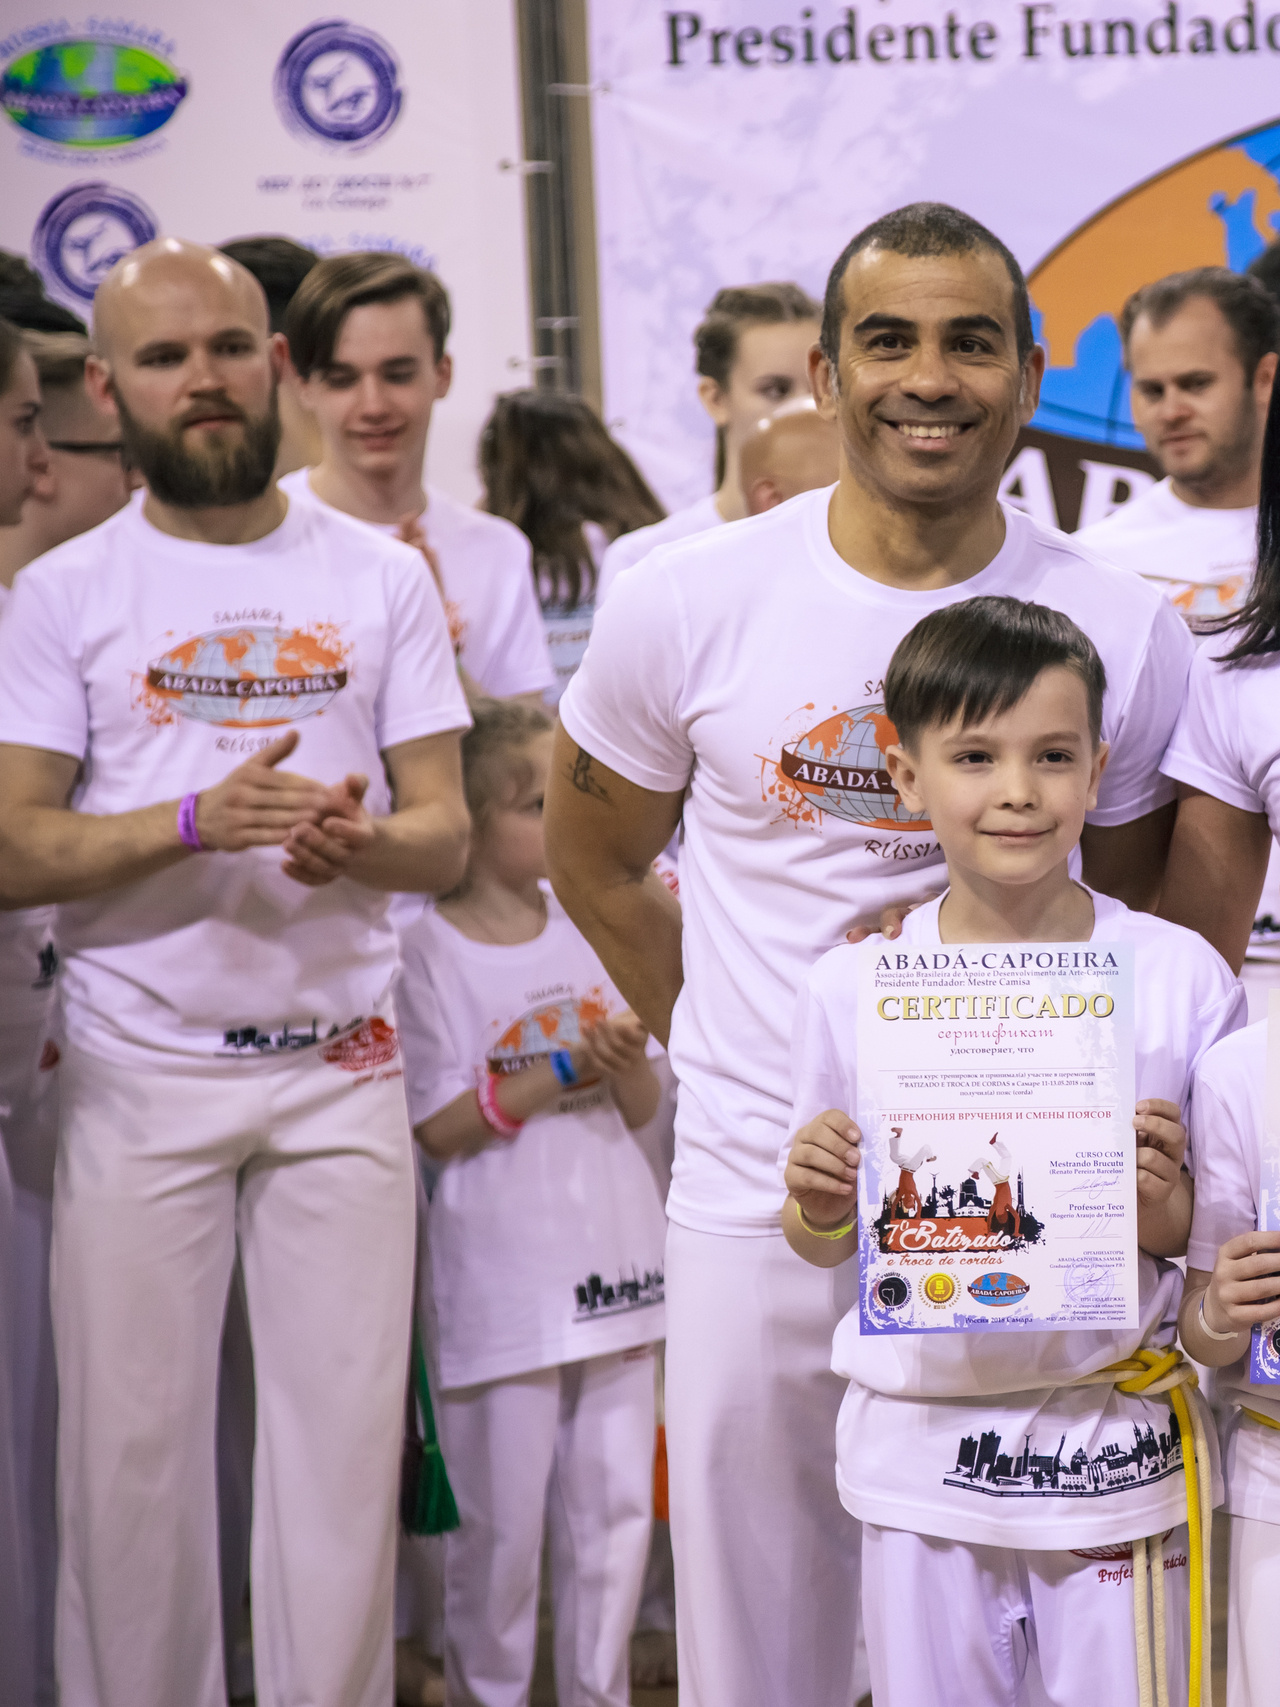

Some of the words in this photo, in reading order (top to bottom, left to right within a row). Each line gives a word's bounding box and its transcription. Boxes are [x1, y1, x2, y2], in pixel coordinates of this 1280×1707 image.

[664, 10, 998, 66] Presidente
[874, 947, 1117, 969] ABADÁ-CAPOEIRA
[874, 978, 919, 987] Presidente
[921, 977, 964, 986] Fundador:
[967, 977, 996, 985] Mestre
[998, 976, 1030, 985] Camisa
[876, 993, 1114, 1021] CERTIFICADO
[937, 1022, 1054, 1046] сертификат
[889, 1112, 955, 1122] ЦЕРЕМОНИЯ
[958, 1112, 1013, 1120] ВРУЧЕНИЯ
[1025, 1111, 1064, 1119] СМЕНЫ
[1067, 1110, 1111, 1119] ПОЯСОВ
[1050, 1159, 1091, 1167] Mestrando
[1106, 1202, 1124, 1210] Teco
[898, 1251, 935, 1265] troca
[938, 1255, 955, 1265] de
[959, 1254, 1004, 1265] cordas
